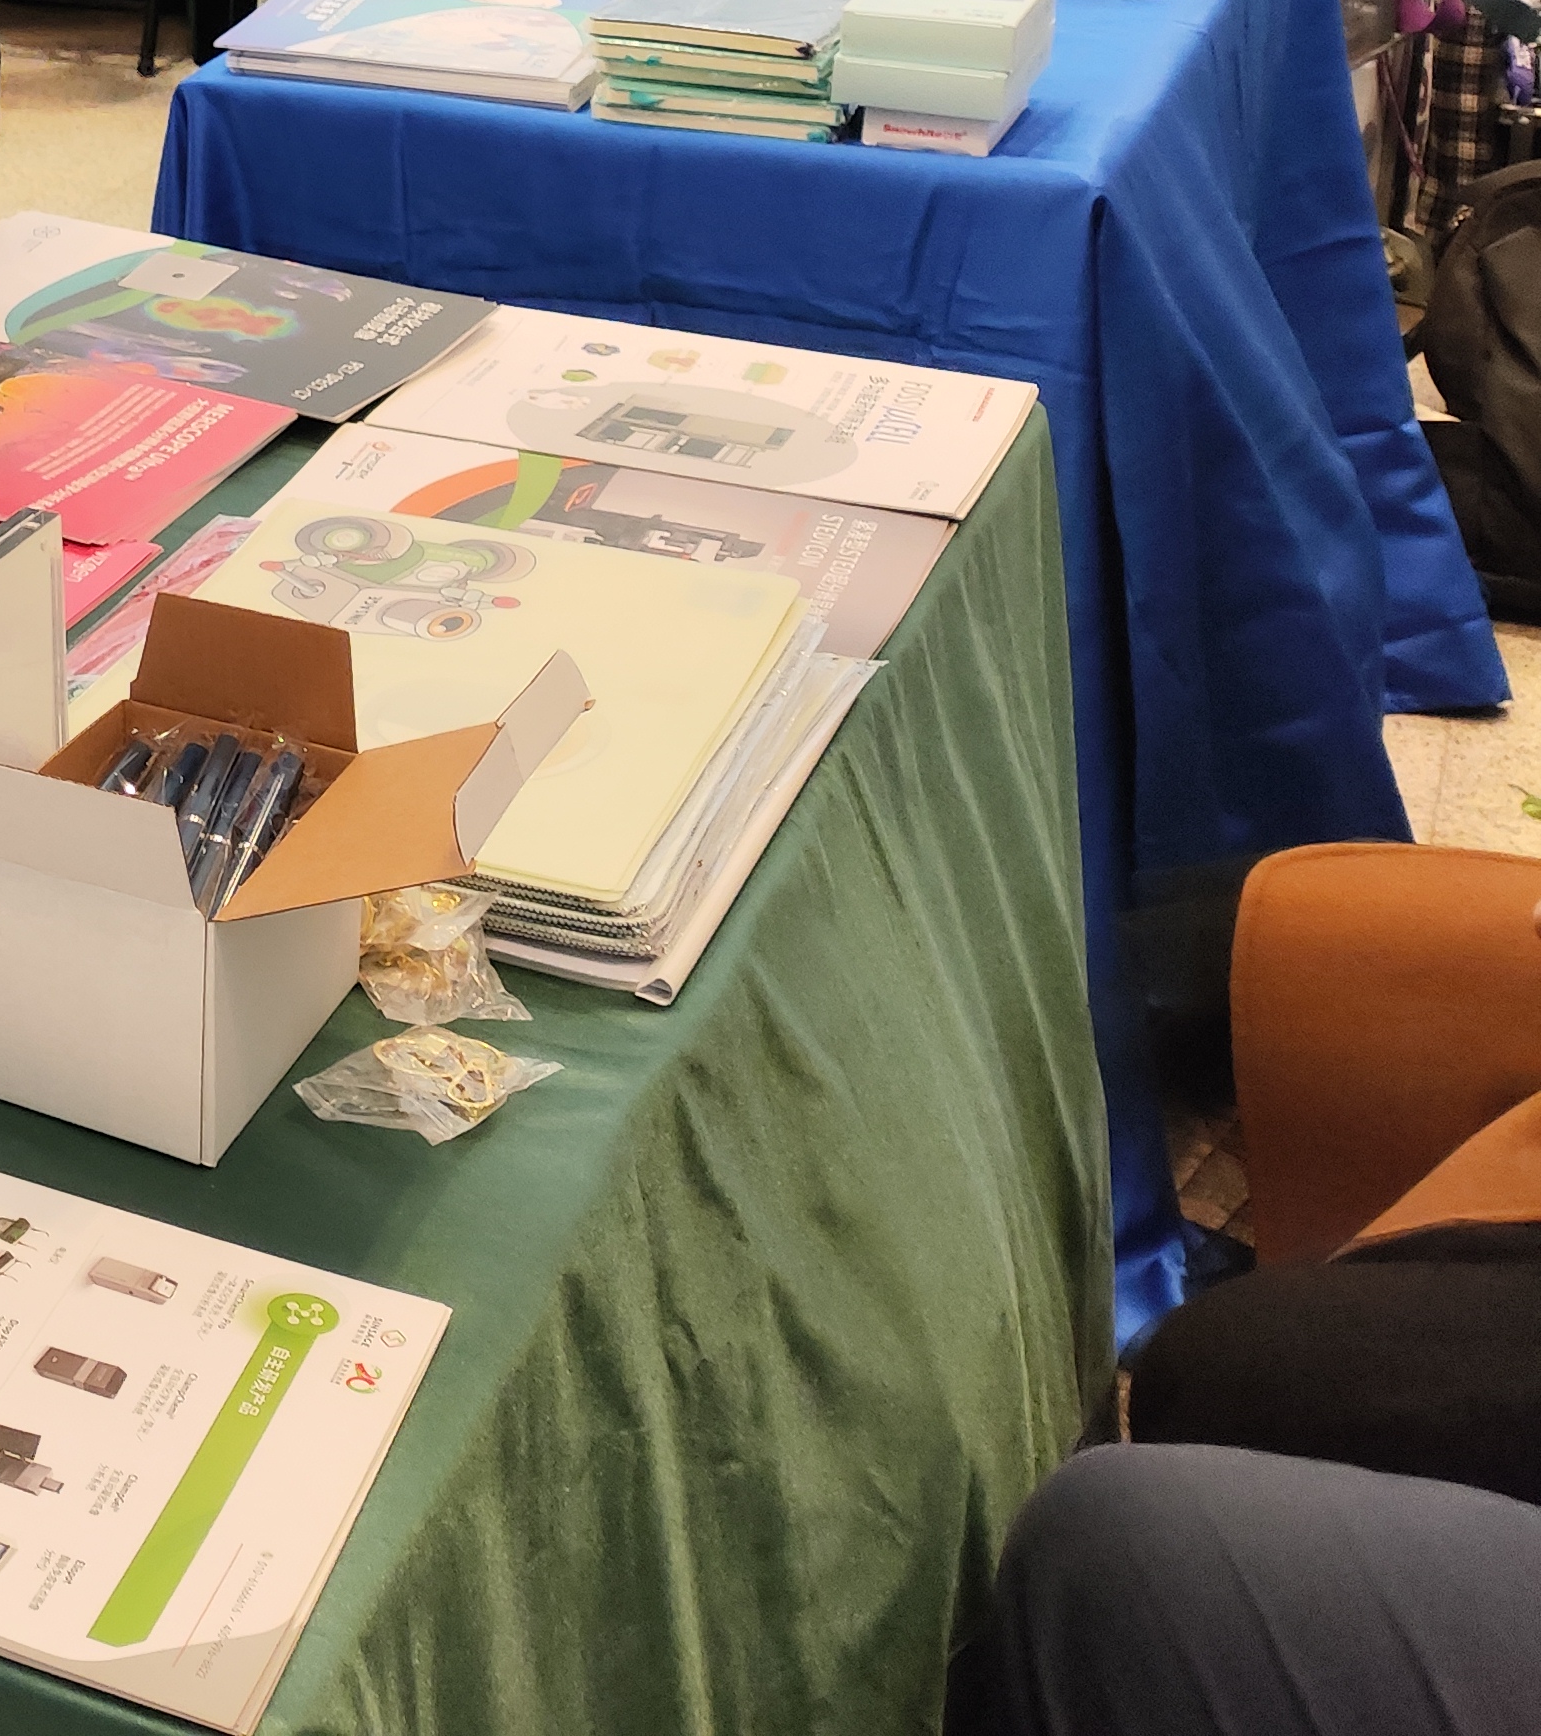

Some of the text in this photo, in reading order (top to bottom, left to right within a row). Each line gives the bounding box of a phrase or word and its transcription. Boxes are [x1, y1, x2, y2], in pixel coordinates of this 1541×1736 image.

[156, 402, 236, 454] MERSCOPE
[795, 512, 845, 568] STEDYCON
[359, 1316, 383, 1348] SINSAGE
[235, 1344, 294, 1419] 自主研发产品
